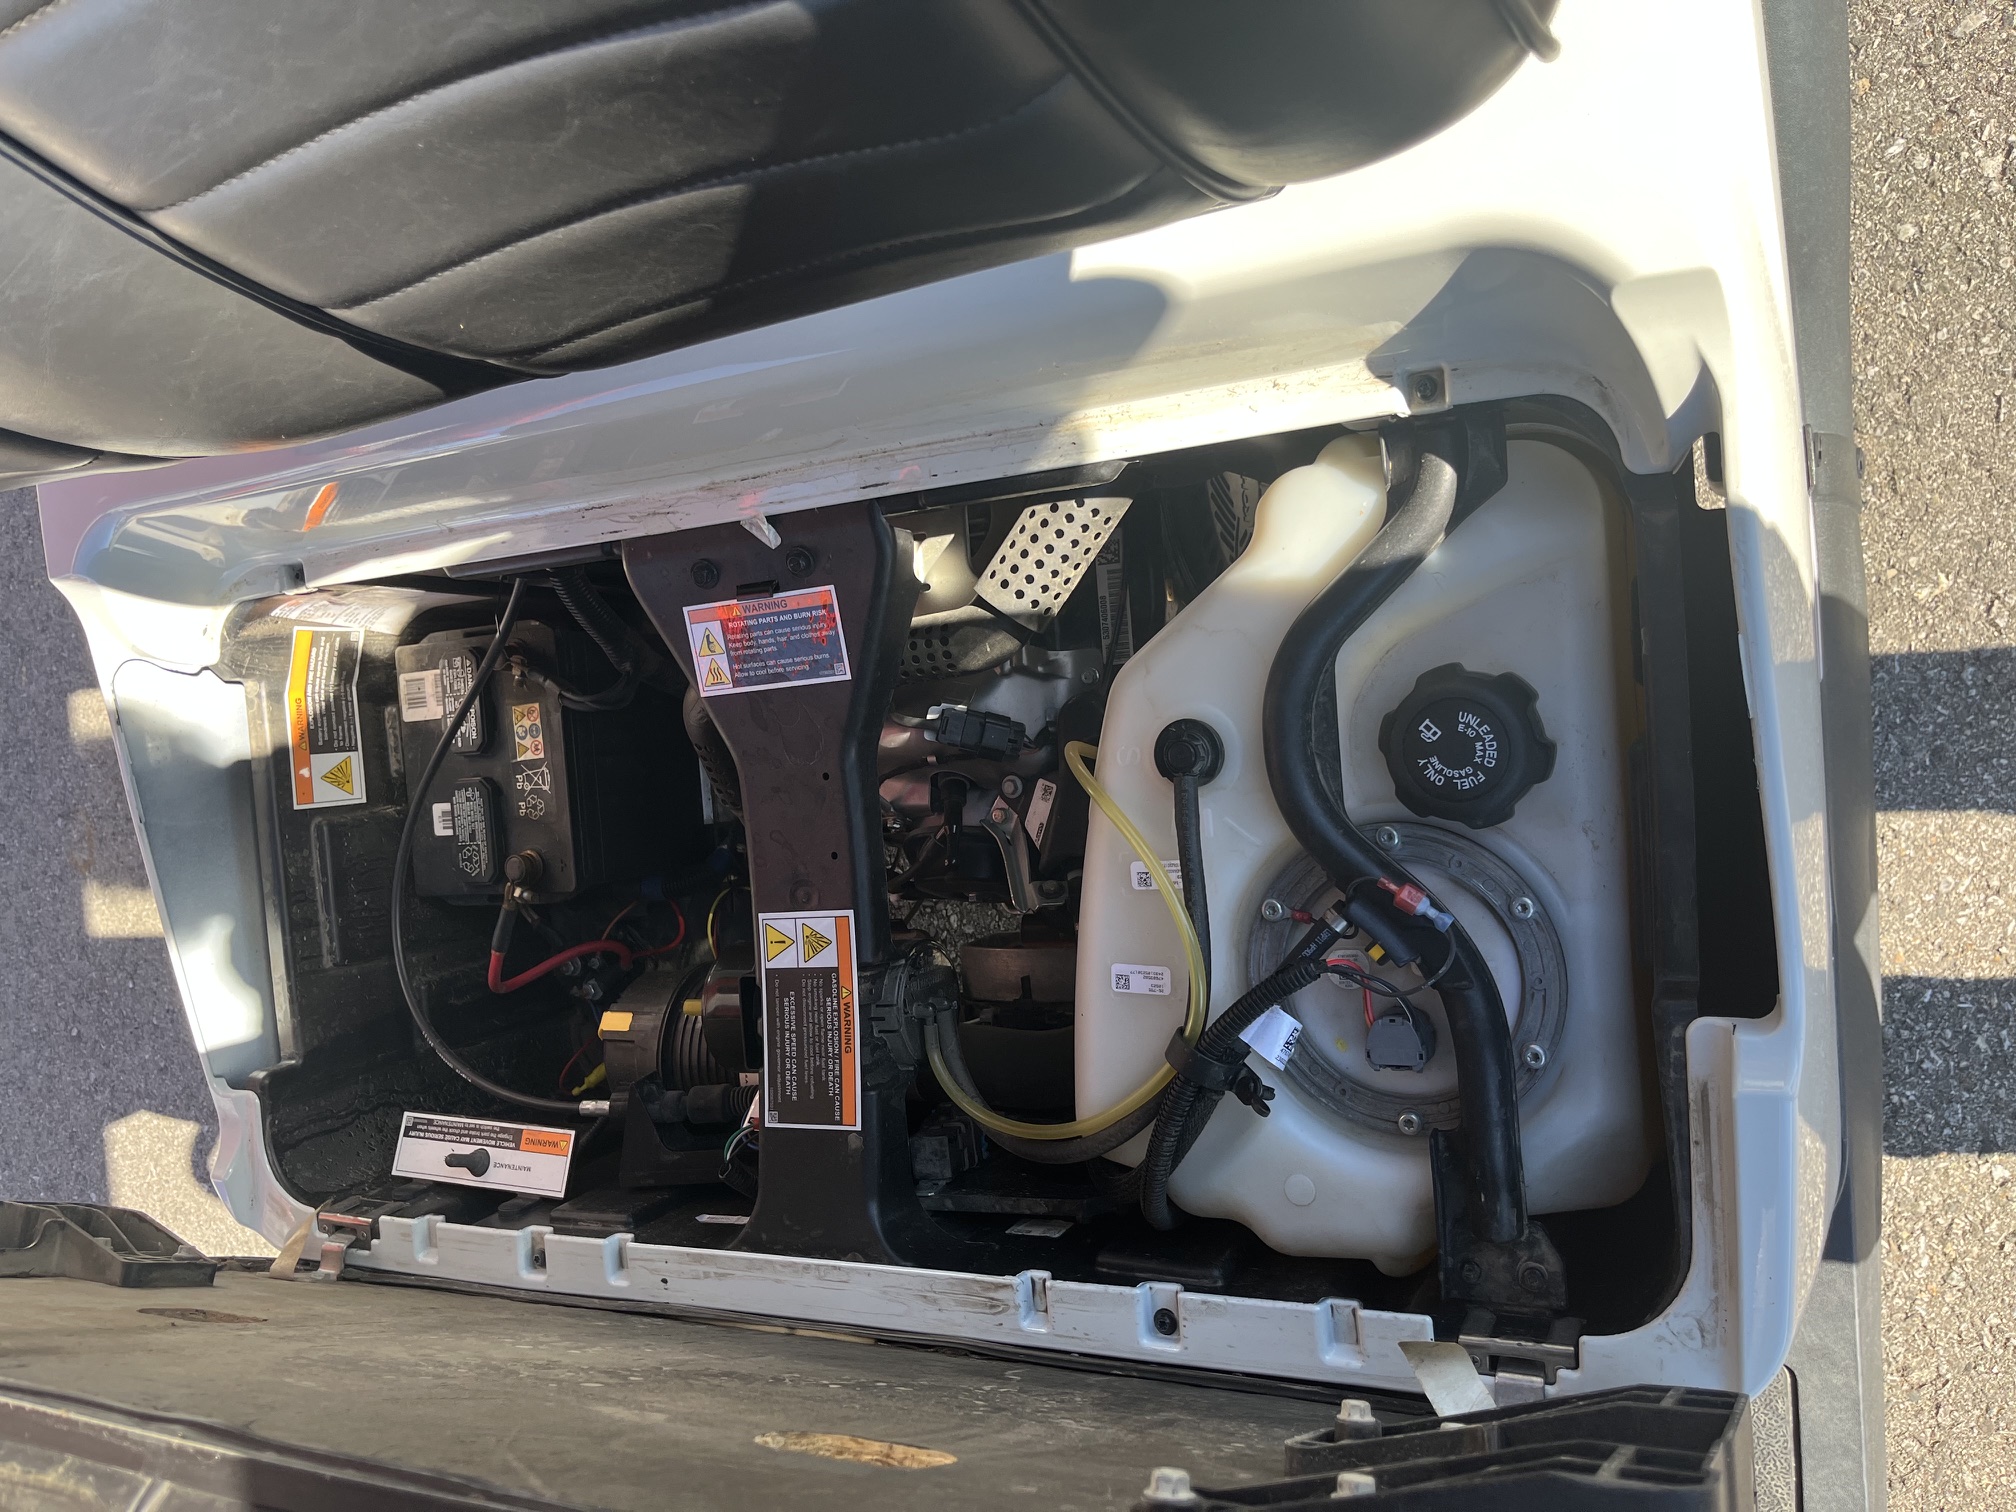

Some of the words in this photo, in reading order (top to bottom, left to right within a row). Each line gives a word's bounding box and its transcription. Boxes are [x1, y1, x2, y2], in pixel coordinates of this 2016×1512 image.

[742, 599, 787, 614] WARNING
[728, 618, 757, 628] ROTATING
[758, 615, 778, 623] PARTS
[778, 613, 792, 621] AND
[1100, 595, 1110, 640] 5307406008
[726, 632, 749, 640] Rotating
[758, 636, 775, 644] hands,
[793, 654, 813, 662] serious
[295, 698, 305, 740] WARNING
[1457, 724, 1476, 738] E-10
[1458, 711, 1498, 768] UNLEADED
[1473, 741, 1484, 764] MAX
[1417, 758, 1445, 786] ONLY
[1429, 755, 1473, 778] GASOLINE
[516, 775, 523, 790] Pb
[1452, 771, 1486, 791] FUEL
[518, 802, 526, 816] Pb
[774, 979, 779, 987] Do
[801, 978, 805, 986] Do
[812, 978, 817, 987] No
[818, 978, 823, 986] No
[843, 1002, 851, 1053] WARNING
[784, 1058, 790, 1068] OR
[827, 1059, 833, 1069] OR
[432, 1119, 464, 1127] MAINTENANCE
[470, 1137, 495, 1145] MOVEMENT
[496, 1132, 512, 1140] Engage
[524, 1137, 559, 1147] WARNING
[492, 1161, 531, 1172] MAINTENANCE
